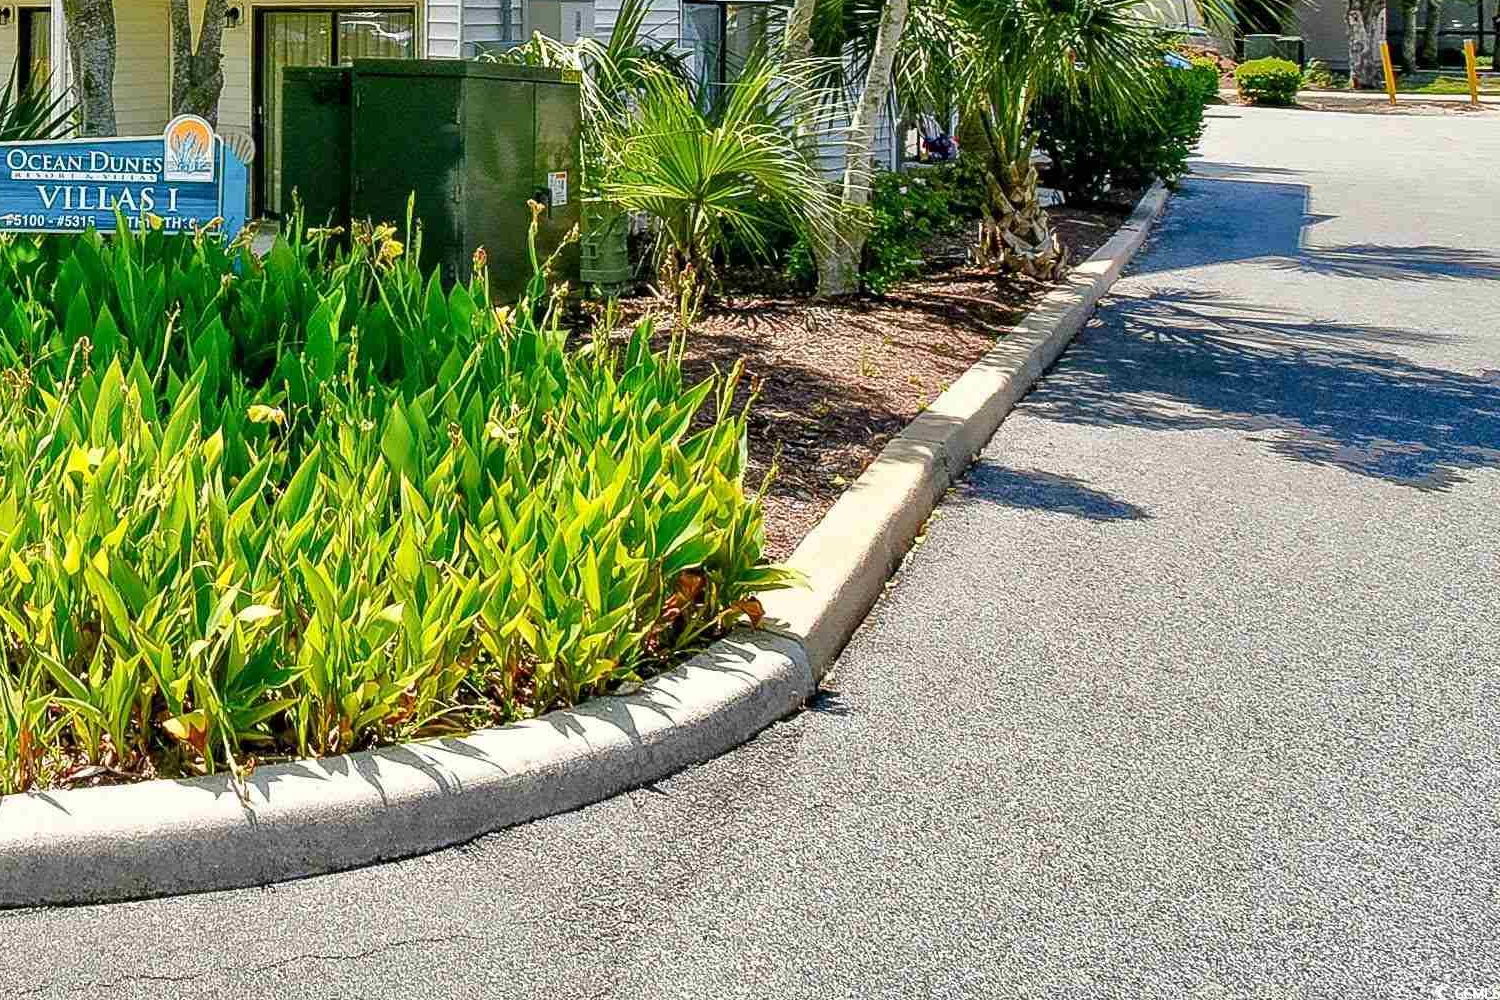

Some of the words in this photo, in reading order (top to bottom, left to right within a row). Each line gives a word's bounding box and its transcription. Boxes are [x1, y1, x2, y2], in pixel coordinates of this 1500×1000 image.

[6, 149, 82, 171] OCEAN
[89, 151, 163, 173] DUNES
[36, 185, 155, 212] VILLAS
[168, 188, 179, 212] I
[5, 214, 45, 226] #5100
[56, 215, 95, 227] #5315
